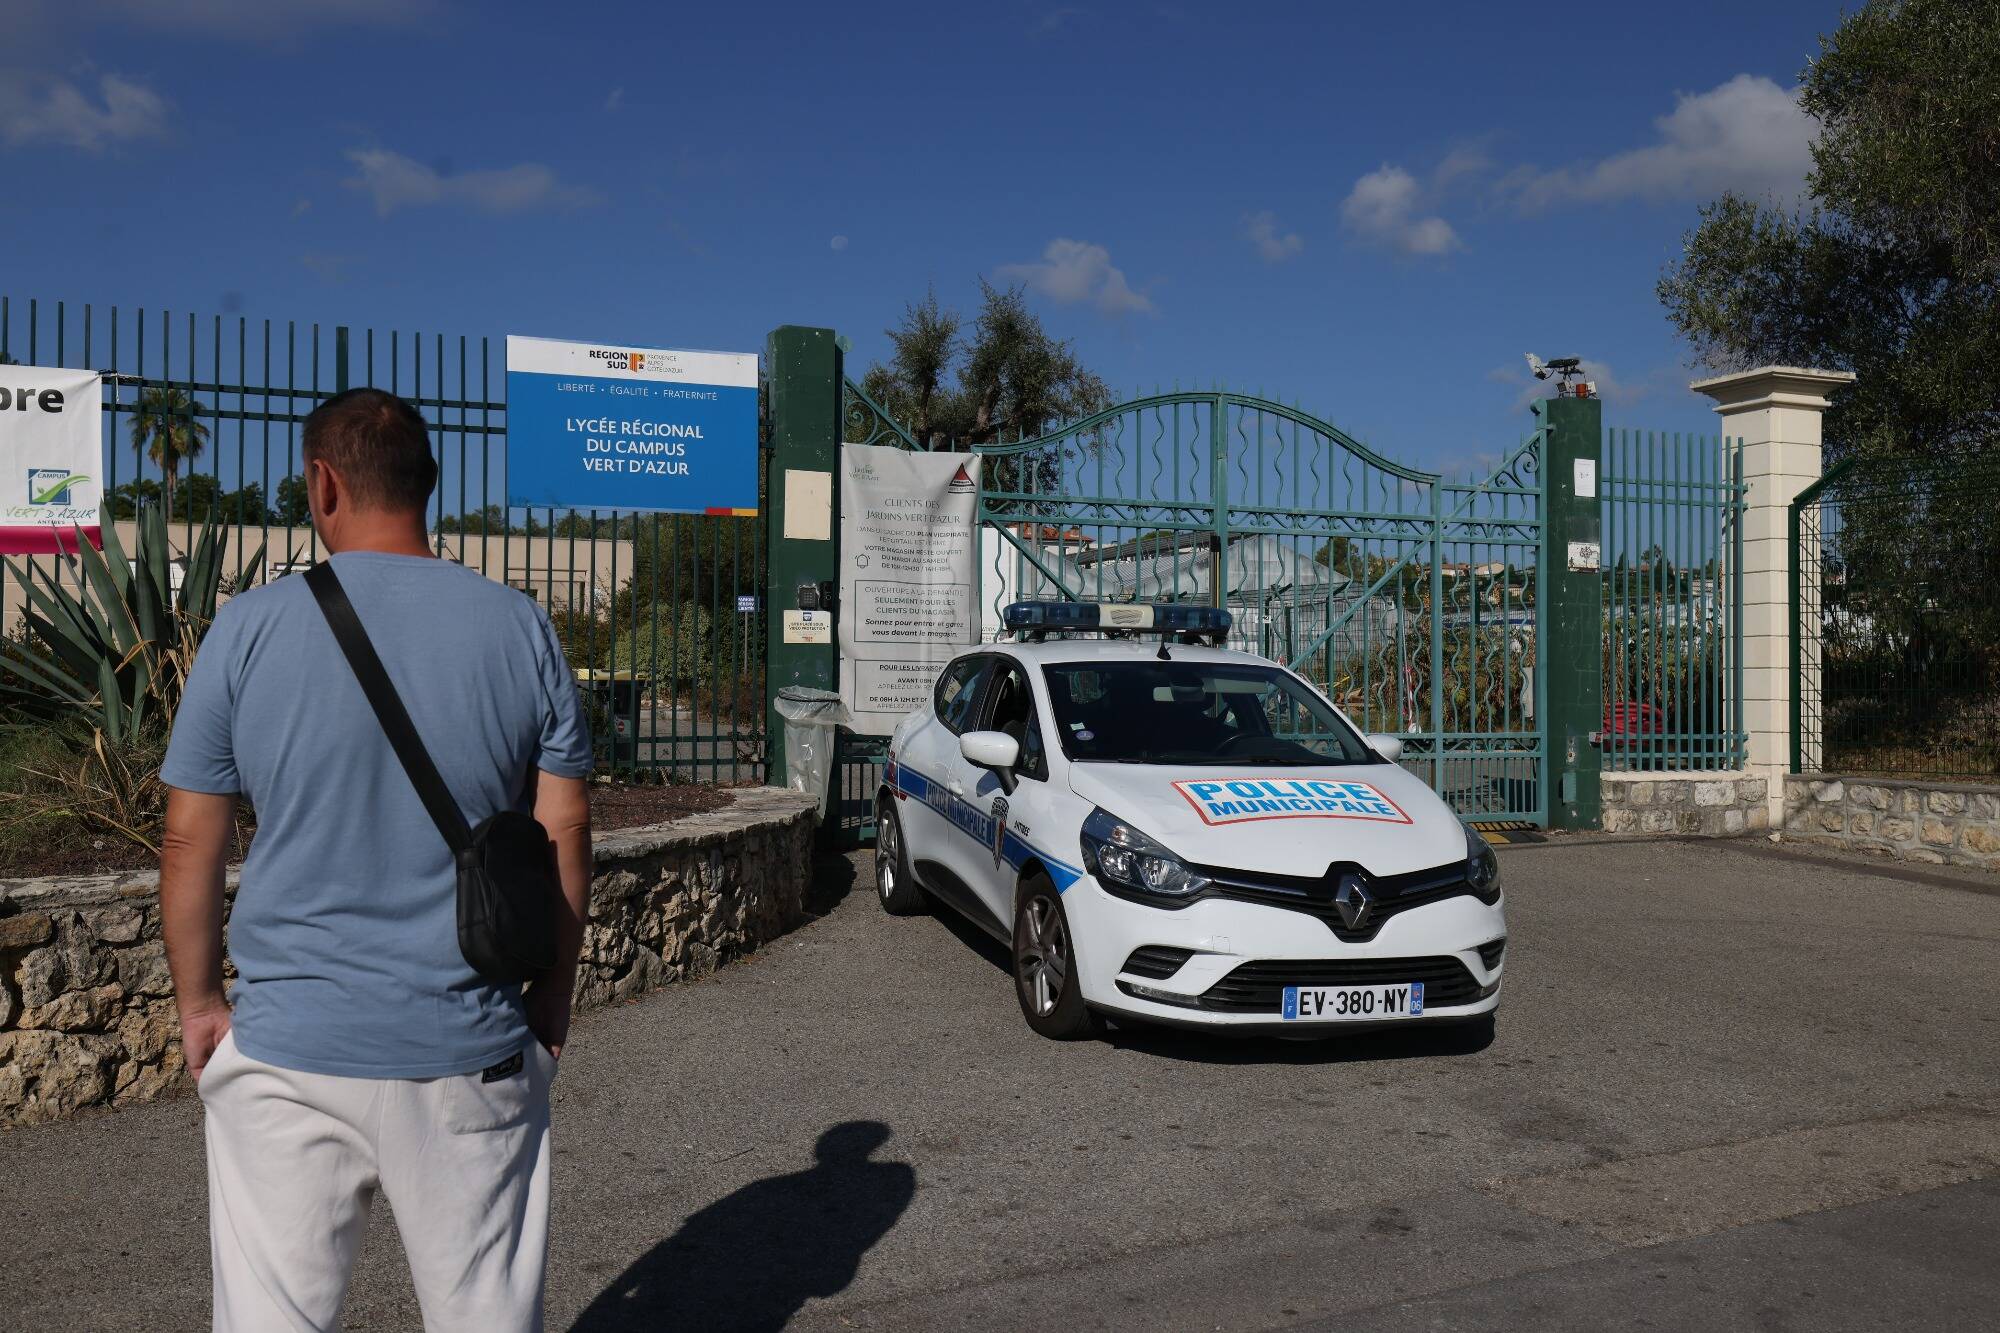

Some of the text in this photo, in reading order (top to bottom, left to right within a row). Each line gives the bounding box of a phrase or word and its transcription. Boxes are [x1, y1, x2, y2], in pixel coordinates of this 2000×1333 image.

[607, 361, 628, 370] SUD
[557, 383, 718, 400] LIBERTÉ ÉGALITÉ FRATERNITÉ
[567, 417, 704, 438] LYCÉE RÉGIONAL
[586, 438, 685, 456] DU CAMPUS
[582, 457, 690, 476] VERT D'AZUR
[6, 506, 44, 518] VERT
[884, 498, 941, 509] CLIENTS DES
[866, 510, 901, 520] JARDINS
[905, 513, 930, 522] VERT
[864, 586, 910, 594] OUVERTURE
[874, 596, 918, 605] SEULEMENT
[1188, 781, 1381, 801] POLICE
[928, 782, 946, 812] POLICE
[948, 793, 986, 842] MUNICIPALE
[1206, 798, 1396, 816] MUNICIPALE
[1300, 988, 1408, 1016] EV-380-NY
[1412, 1000, 1422, 1012] 06
